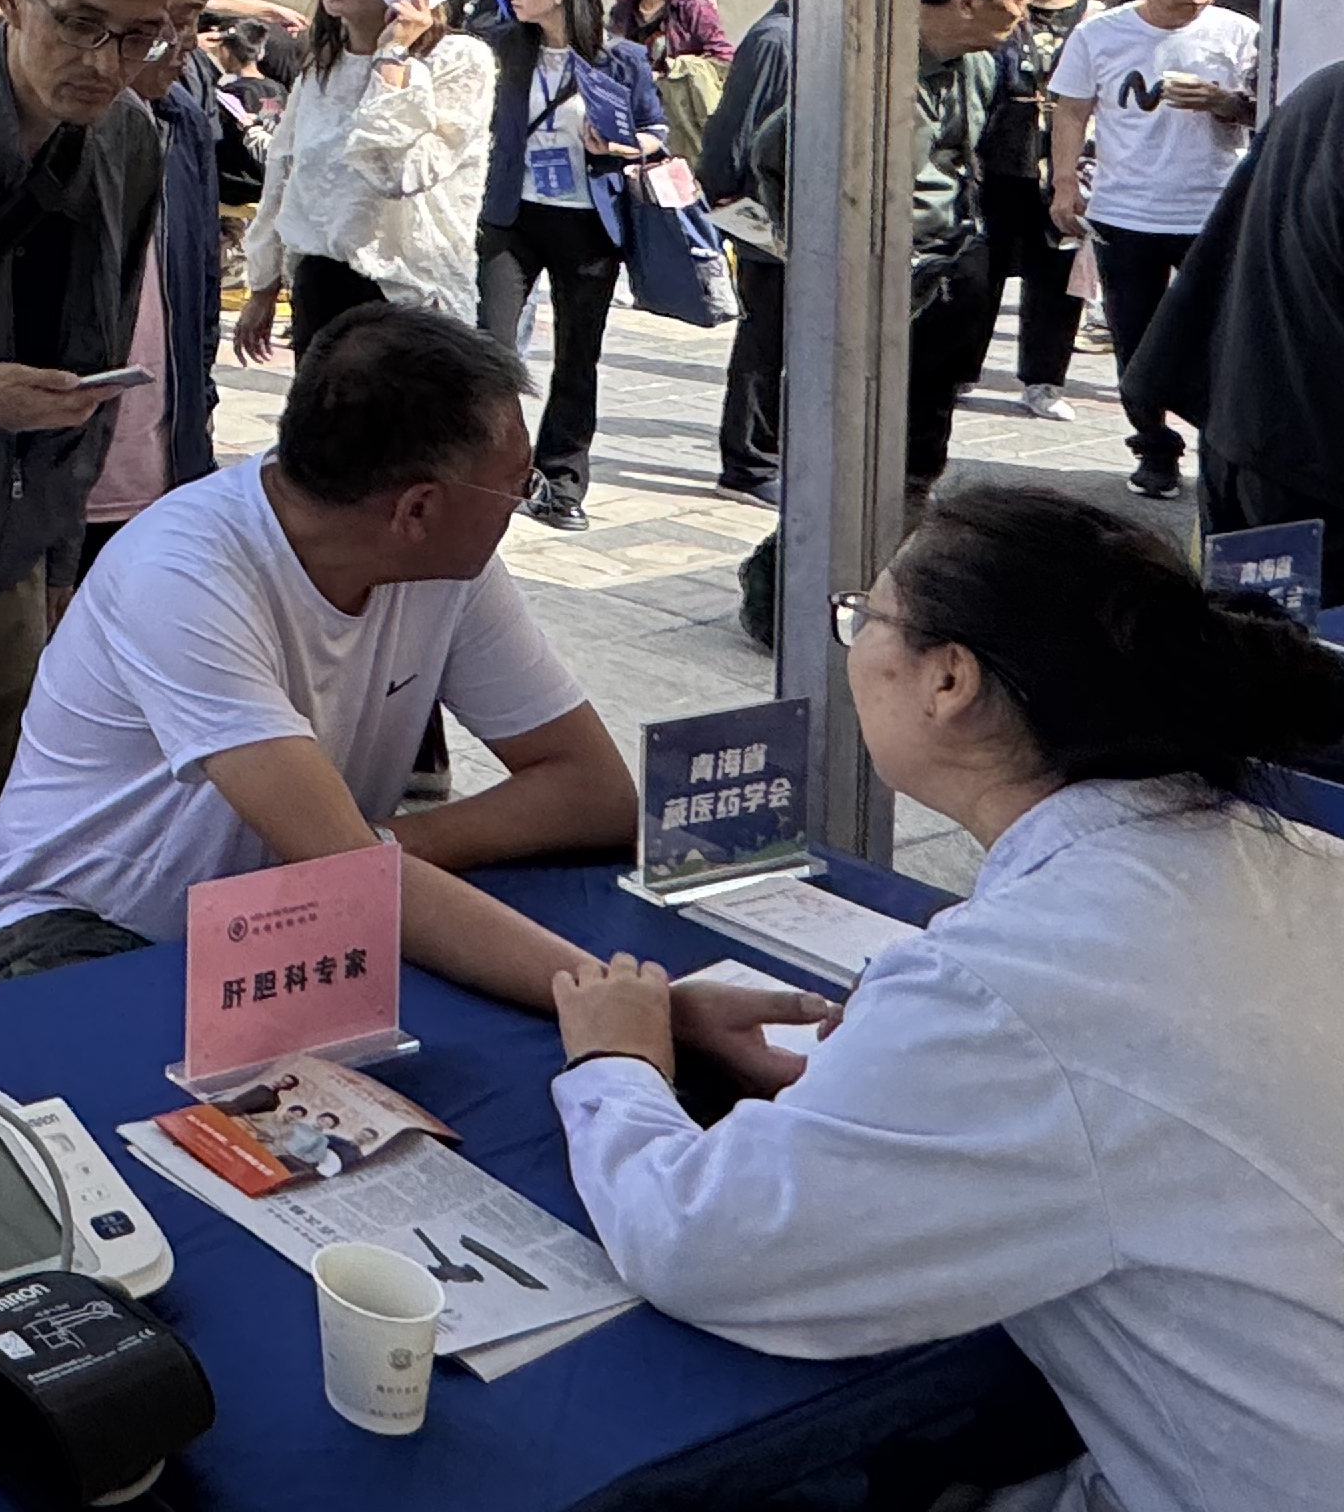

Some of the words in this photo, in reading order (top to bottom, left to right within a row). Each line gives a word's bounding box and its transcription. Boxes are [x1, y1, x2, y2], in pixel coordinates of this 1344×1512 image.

[690, 742, 768, 784] 青海省
[662, 777, 792, 831] 藏医药学会
[221, 948, 368, 1010] 肝胆科专家
